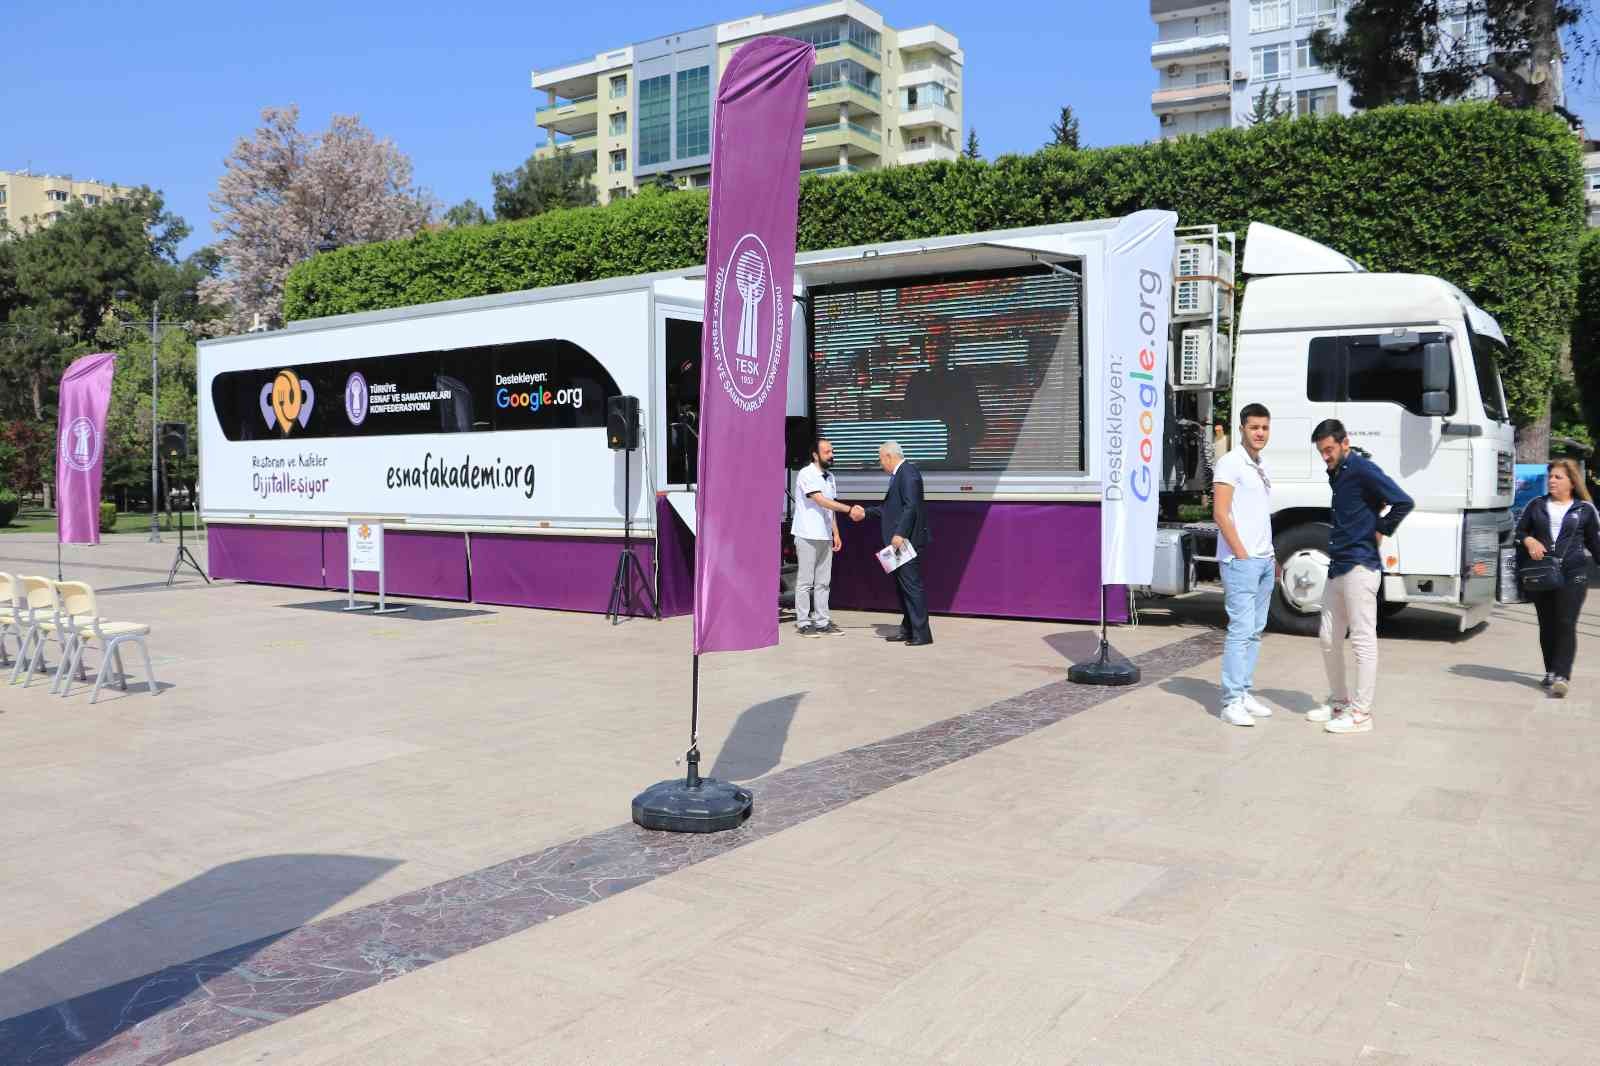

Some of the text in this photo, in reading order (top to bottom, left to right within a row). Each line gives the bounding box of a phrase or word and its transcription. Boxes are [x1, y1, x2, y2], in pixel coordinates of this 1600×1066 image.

[717, 362, 727, 381] VE
[736, 358, 759, 376] TESK
[370, 383, 397, 393] TÜRKİYE
[495, 372, 548, 386] Destekleyen:
[1130, 269, 1161, 502] Google.org
[369, 390, 452, 404] ESNAF VE SANATKARLARI
[496, 385, 583, 412] Google.org
[369, 402, 431, 414] KONFEDERASYONU
[1104, 353, 1127, 502] Destekleyen:
[252, 452, 328, 468] Restoran ve Kafeler
[386, 452, 536, 499] esnafakademi.org
[253, 472, 328, 499] Dijitalleşiyor
